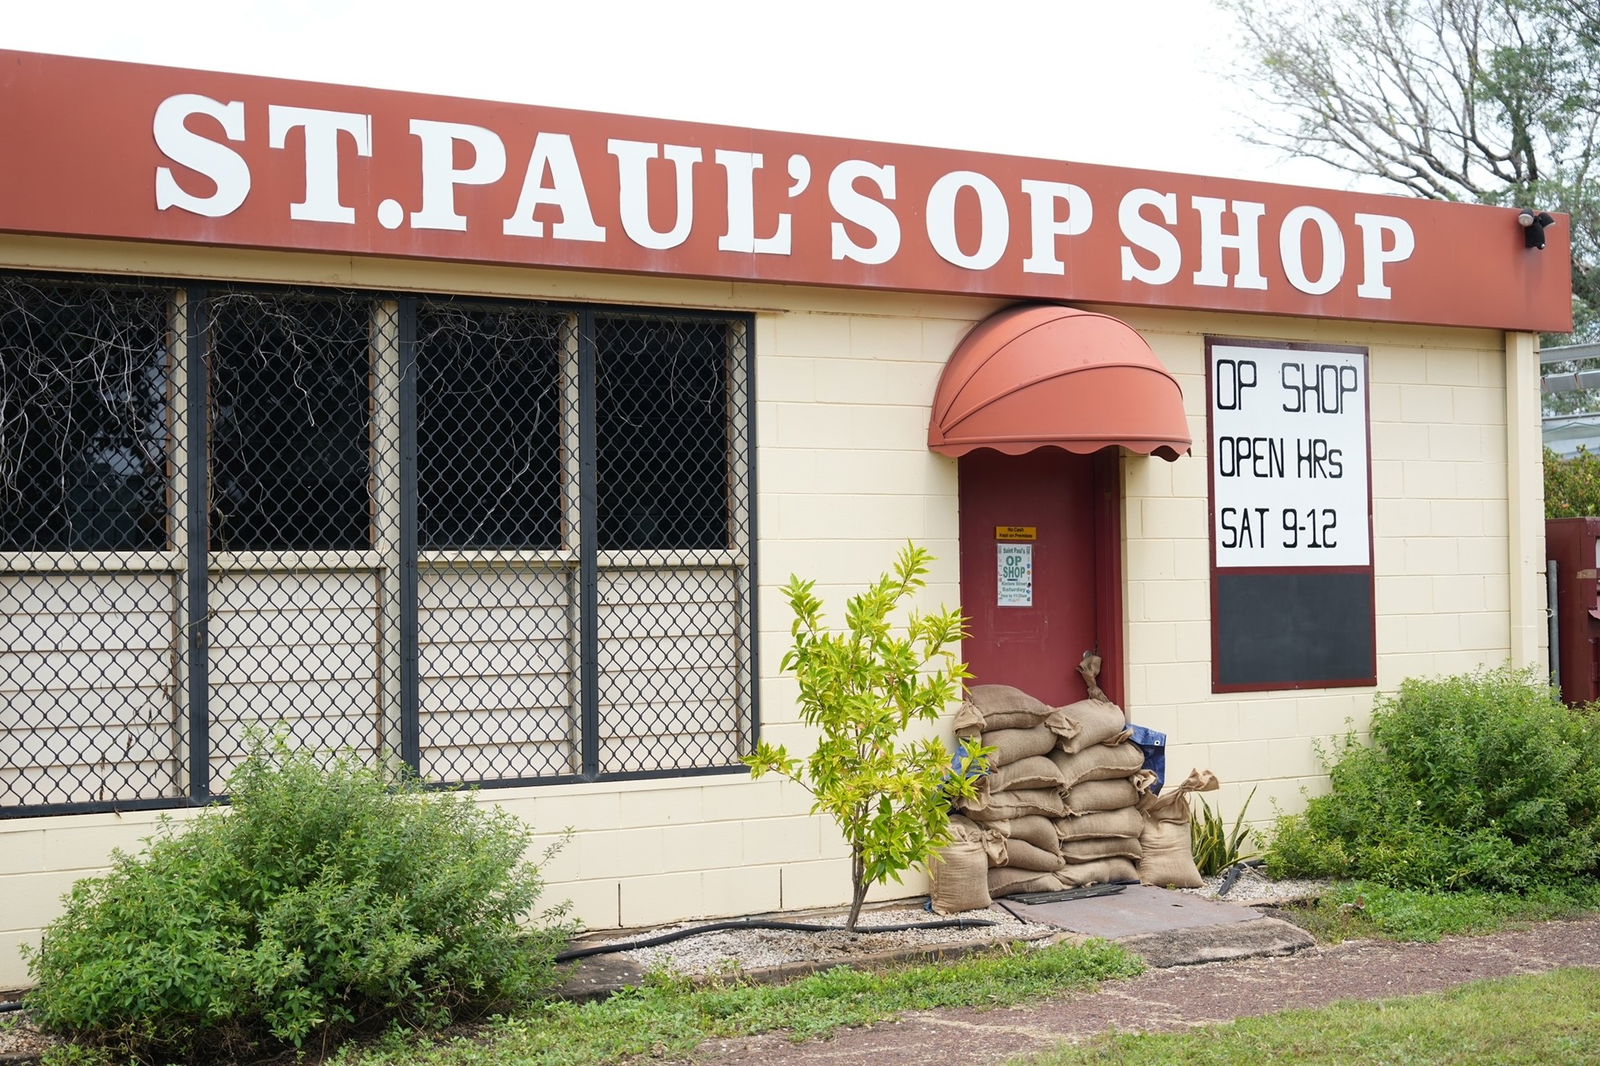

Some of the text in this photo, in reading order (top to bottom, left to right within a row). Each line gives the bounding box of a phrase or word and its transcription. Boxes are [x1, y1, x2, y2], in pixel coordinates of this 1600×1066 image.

[926, 171, 1093, 275] OP
[1118, 188, 1415, 299] SHOP
[1217, 359, 1358, 414] OP SHOP
[1219, 436, 1285, 478] OPEN
[1221, 507, 1337, 549] SAT 9-12
[1003, 566, 1026, 578] SHOP
[1006, 555, 1022, 566] OP
